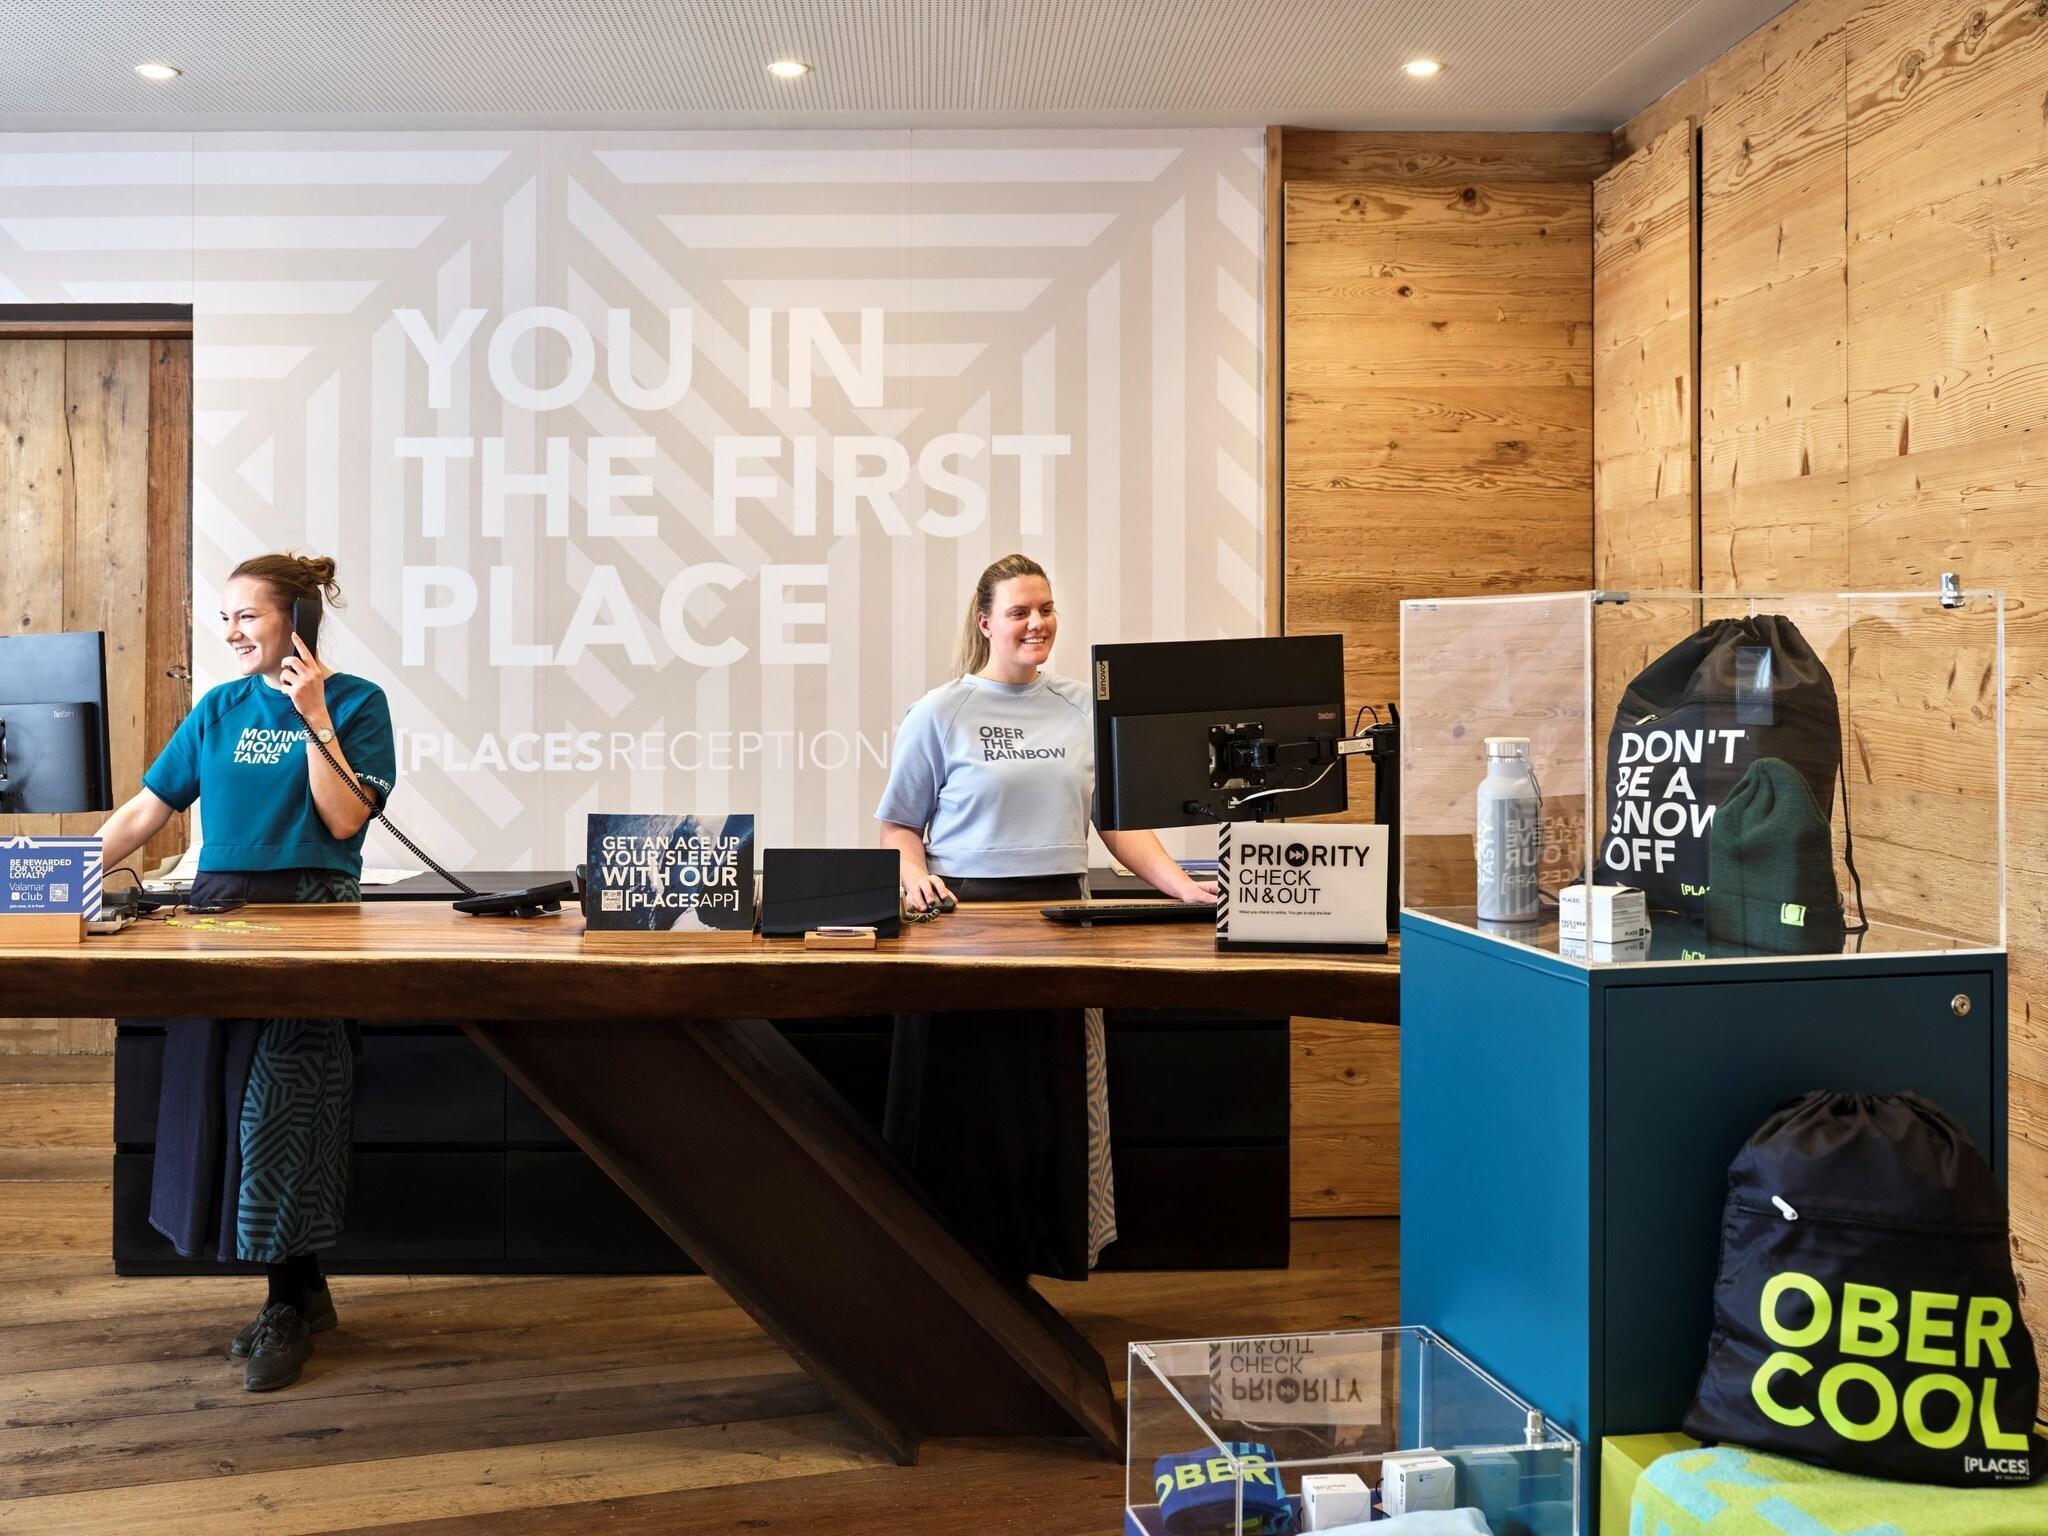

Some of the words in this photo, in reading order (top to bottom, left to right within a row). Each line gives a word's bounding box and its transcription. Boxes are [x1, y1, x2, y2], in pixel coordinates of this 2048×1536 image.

[393, 305, 693, 411] YOU
[748, 306, 884, 408] IN
[394, 436, 659, 537] THE
[713, 433, 1071, 538] FIRST
[401, 564, 831, 667] PLACE
[1099, 663, 1107, 697] Lenovo
[979, 726, 1025, 740] OBER
[236, 739, 292, 753] MOUN
[980, 738, 1014, 749] THE
[1617, 729, 1746, 764] DON'T
[233, 751, 281, 764] TAINS
[984, 747, 1066, 762] RAINBOW
[1615, 765, 1655, 798] BE
[1662, 766, 1697, 800] A
[602, 836, 638, 850] GET
[643, 837, 669, 850] AN
[675, 836, 711, 850] ACE
[717, 836, 740, 850] UP
[602, 850, 659, 866] YOUR
[665, 850, 738, 866] SLEEVE
[1240, 843, 1370, 867] PRIORITY
[1480, 822, 1495, 885] TASTY
[1605, 836, 1676, 874] OFF
[30, 865, 54, 873] YOUR
[602, 866, 670, 886] WITH
[679, 866, 738, 886] OUR
[1239, 869, 1312, 886] CHECK
[9, 882, 45, 891] Valamar
[21, 892, 43, 901] Club
[1759, 1271, 2013, 1369] OBER
[1751, 1351, 2030, 1451] COOL
